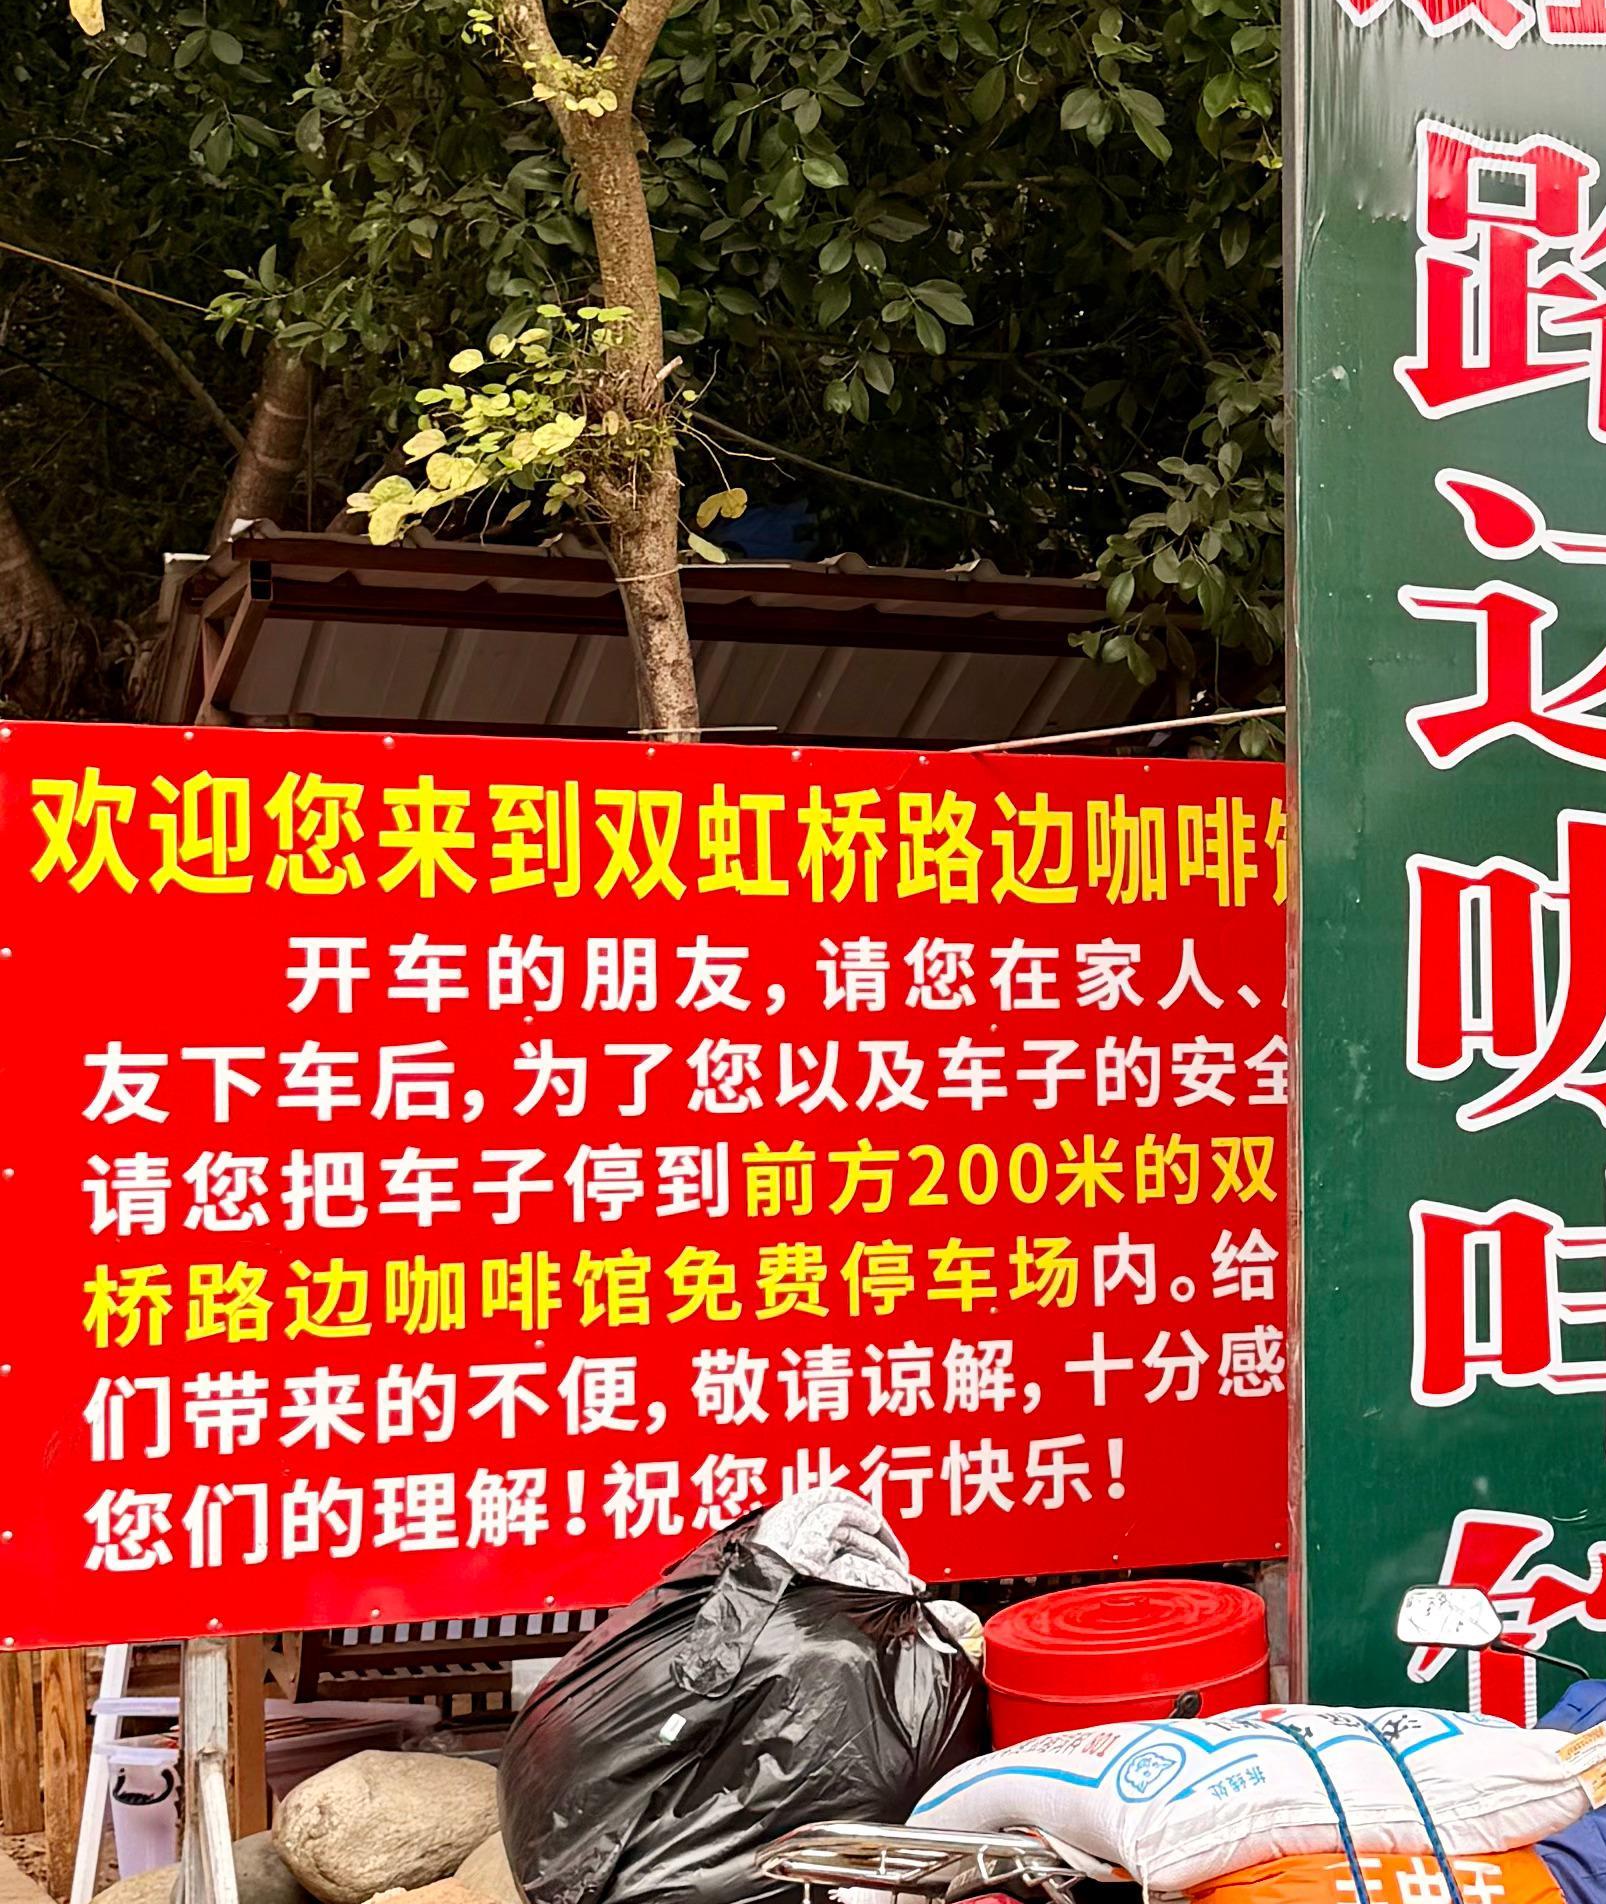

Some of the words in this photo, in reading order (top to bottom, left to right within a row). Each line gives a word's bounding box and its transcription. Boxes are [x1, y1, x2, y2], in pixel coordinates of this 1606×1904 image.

[30, 767, 1287, 908] 欢迎您来到双虹桥路边咖啡
[286, 934, 1287, 1014] 开车的朋友，请您在家人、
[82, 1134, 1276, 1237] 请您把车子停到前方200米的双
[82, 1228, 1277, 1348] 桥路边咖啡馆免费停车场内。给
[83, 1325, 1285, 1462] 们带来的不便，敬请谅解，十分感
[1208, 1765, 1265, 1799] 拆线处
